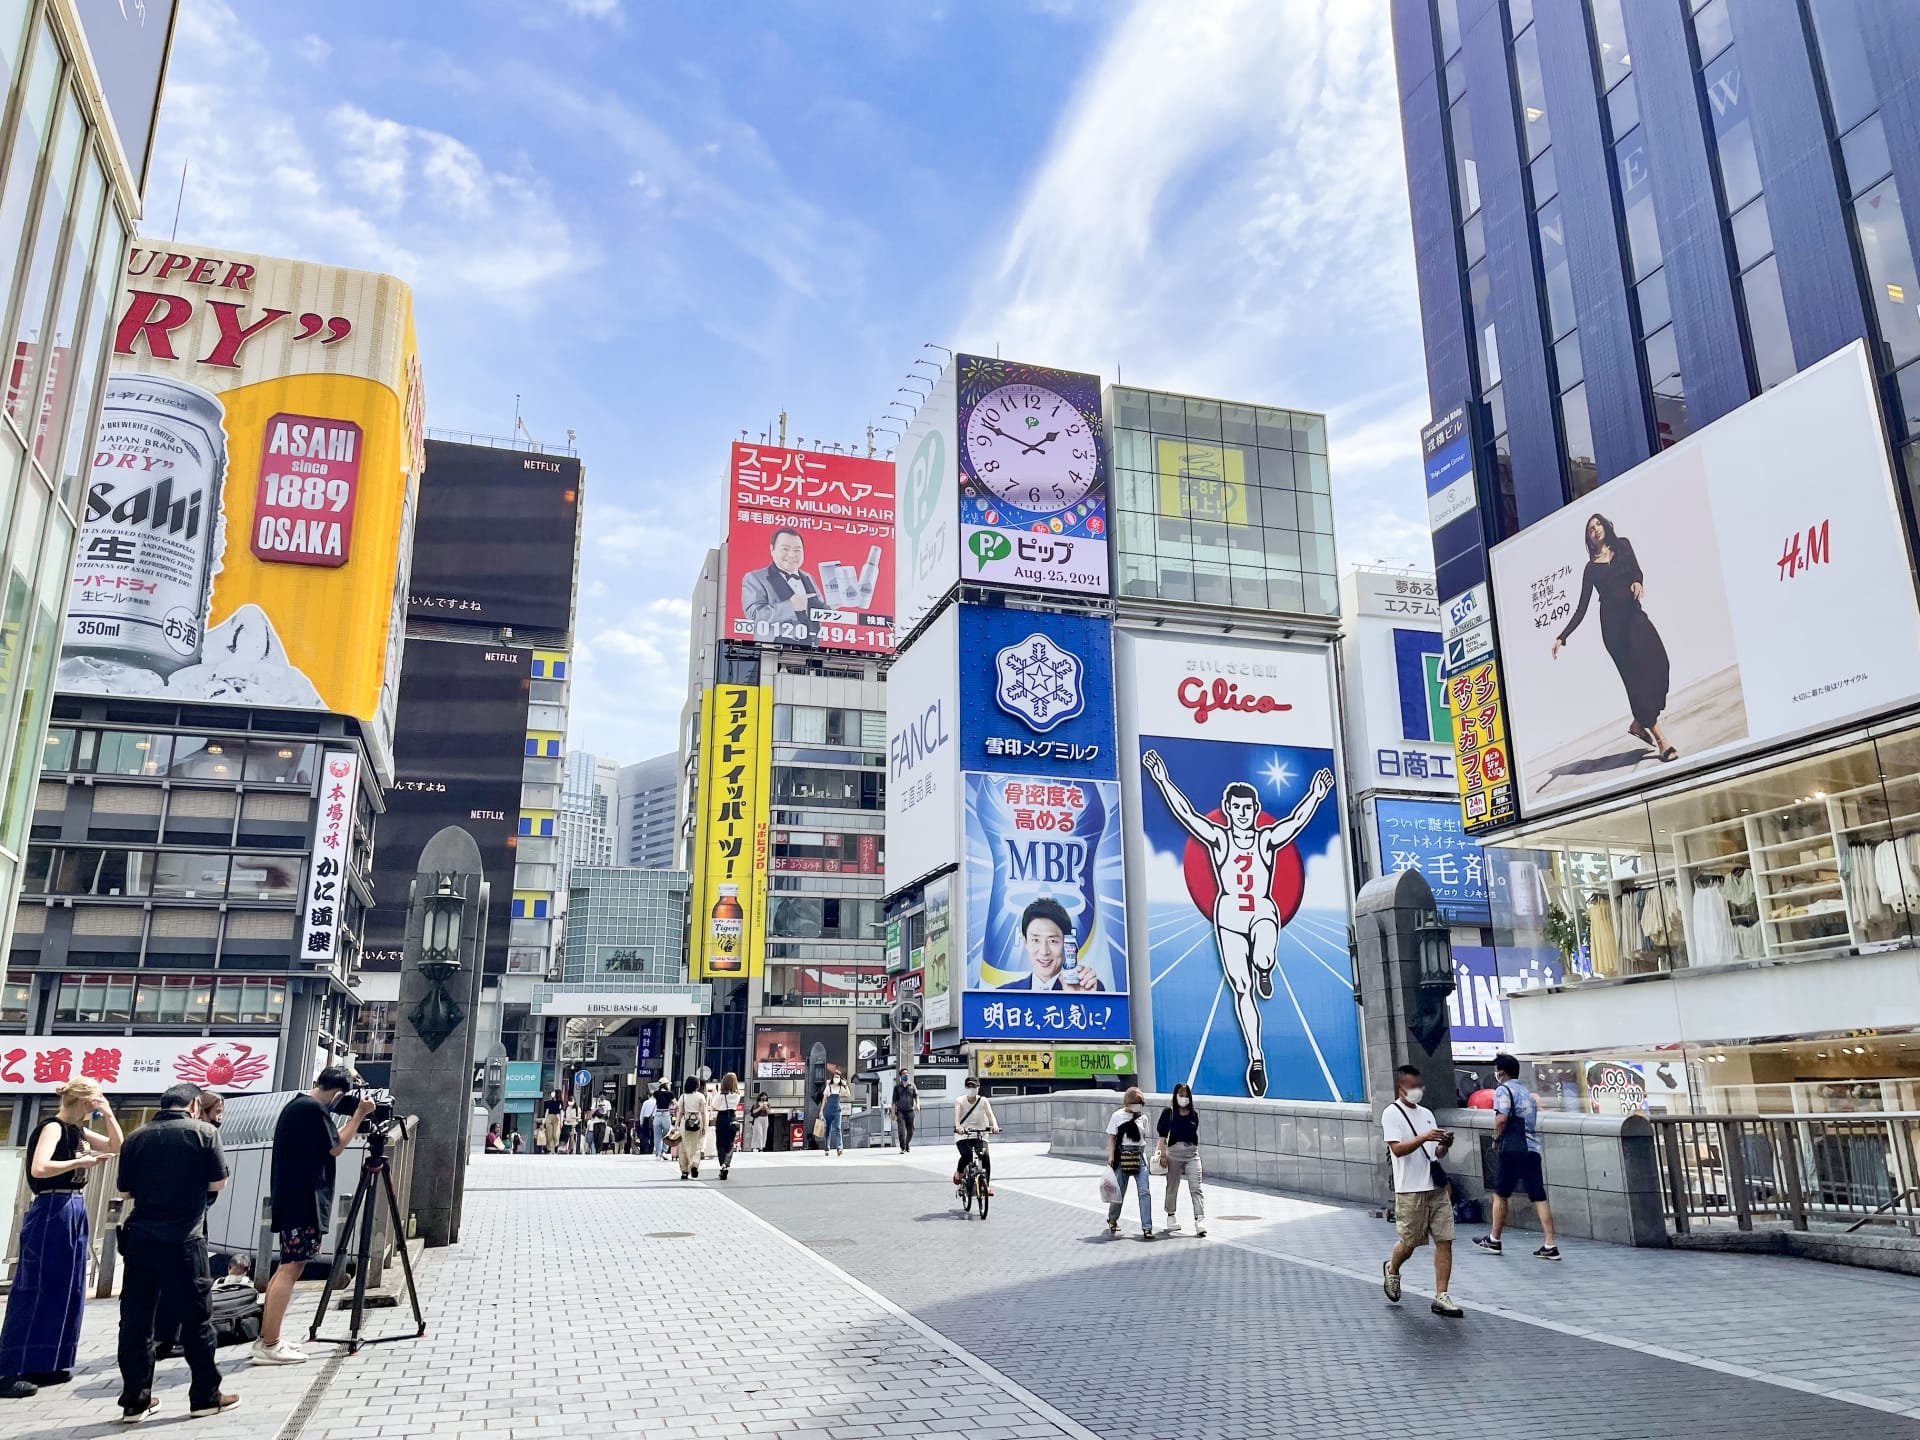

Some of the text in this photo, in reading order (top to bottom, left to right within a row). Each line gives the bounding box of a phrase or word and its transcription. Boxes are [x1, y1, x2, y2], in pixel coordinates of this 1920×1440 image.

[1022, 394, 1041, 410] 12
[145, 439, 184, 455] BRAND
[269, 422, 354, 463] ASAHI
[292, 459, 328, 475] since
[523, 458, 561, 473] NETFLIX
[738, 446, 827, 474] スーパー
[264, 474, 350, 513] 1889
[738, 468, 895, 502] ミリオンヘアー
[1029, 487, 1041, 503] 6
[737, 492, 894, 521] SUPER MILLION HAIR
[258, 515, 342, 558] OSAKA
[87, 535, 137, 564] 生
[1018, 538, 1074, 565] ピップ
[1777, 519, 1830, 582] H&M
[1015, 566, 1045, 583] Aug.
[1070, 573, 1101, 586] 2021
[1531, 564, 1573, 592] サステナブル
[1533, 590, 1567, 613] ワンピース
[77, 620, 121, 637] 350ml
[812, 611, 843, 622] ルアン
[1534, 602, 1571, 630] ¥2,499
[165, 617, 198, 649] お酒
[485, 652, 518, 664] NETFLIX
[890, 698, 949, 784] FANCL
[984, 737, 1099, 762] 雪印メグミルク
[1004, 783, 1084, 809] 骨密度を
[470, 809, 505, 821] NETFLIX
[1014, 809, 1076, 833] 高める
[775, 859, 788, 869] 5F
[1006, 840, 1083, 883] MBP
[1233, 851, 1256, 913] グリコ
[772, 1067, 803, 1075] Editorial
[937, 1055, 960, 1063] Toilets
